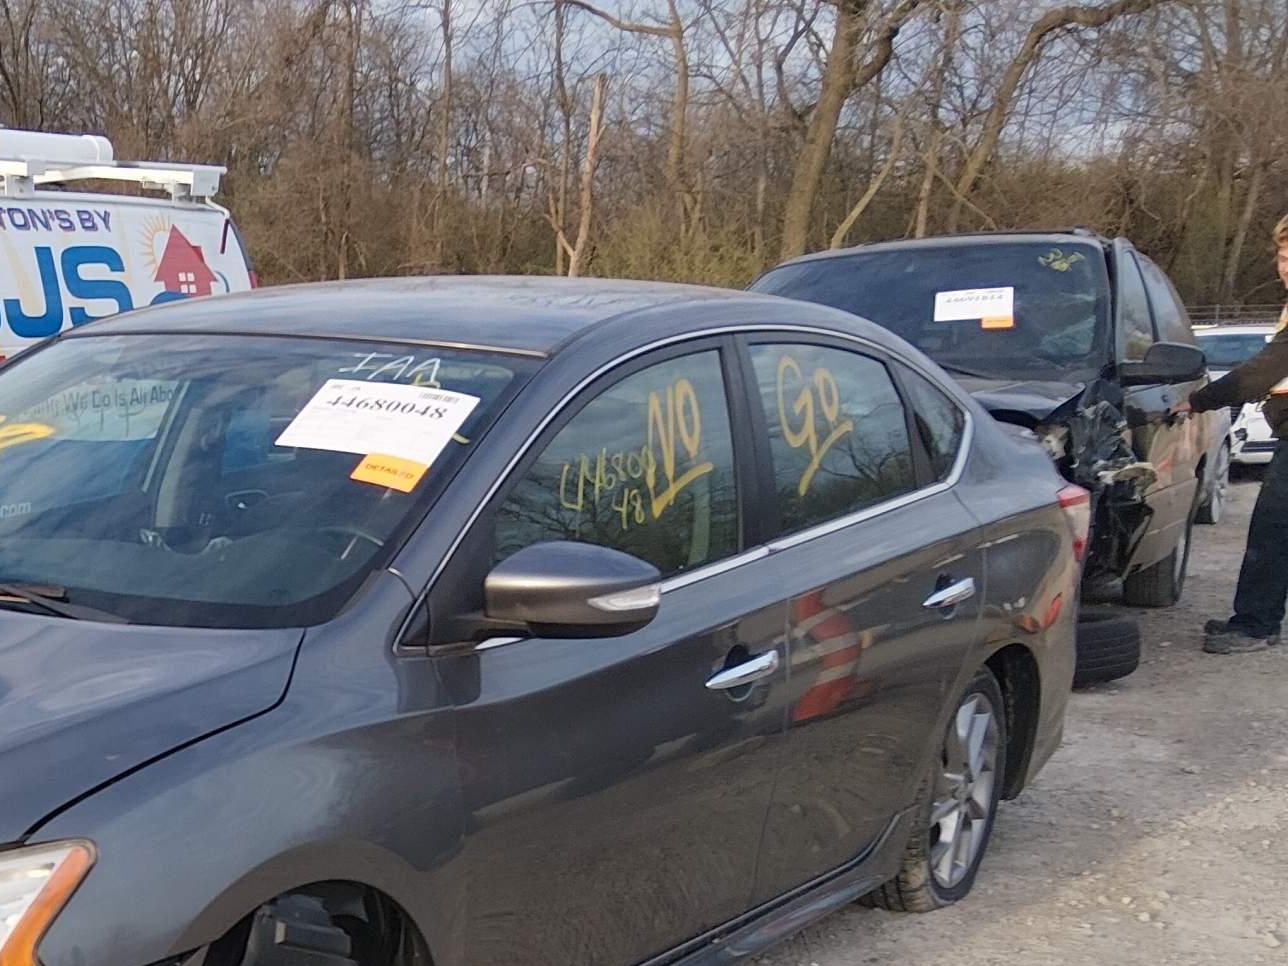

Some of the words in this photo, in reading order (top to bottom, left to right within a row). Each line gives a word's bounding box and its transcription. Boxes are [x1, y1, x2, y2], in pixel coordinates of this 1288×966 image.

[78, 209, 111, 233] BY
[338, 352, 441, 381] IAA
[326, 395, 448, 419] 44680048
